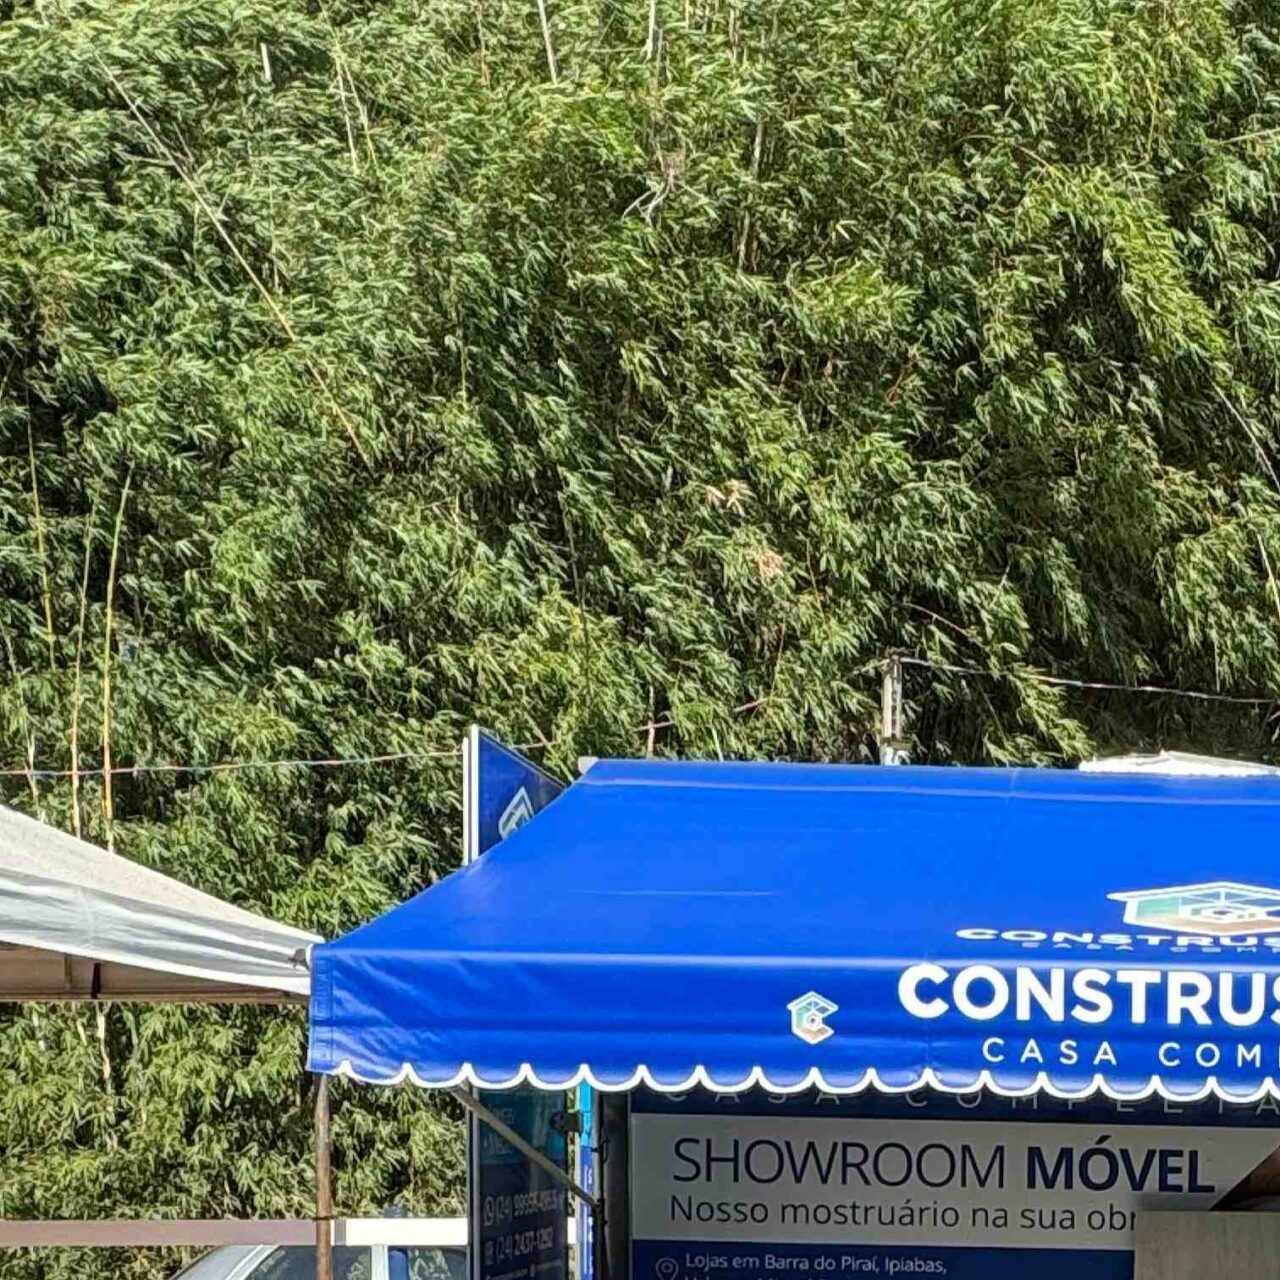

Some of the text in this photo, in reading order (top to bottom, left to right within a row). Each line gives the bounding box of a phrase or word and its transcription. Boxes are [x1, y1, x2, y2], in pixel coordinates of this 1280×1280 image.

[982, 1036, 1117, 1067] CASA
[673, 1134, 1216, 1194] SHOWROOM MÓVEL
[669, 1194, 769, 1225] Nosso
[780, 1196, 960, 1229] mostruário
[971, 1203, 1009, 1229] na
[1019, 1206, 1077, 1231] sua
[685, 1253, 947, 1276] Lojas em Barra do Piraí, Ipiabas,
